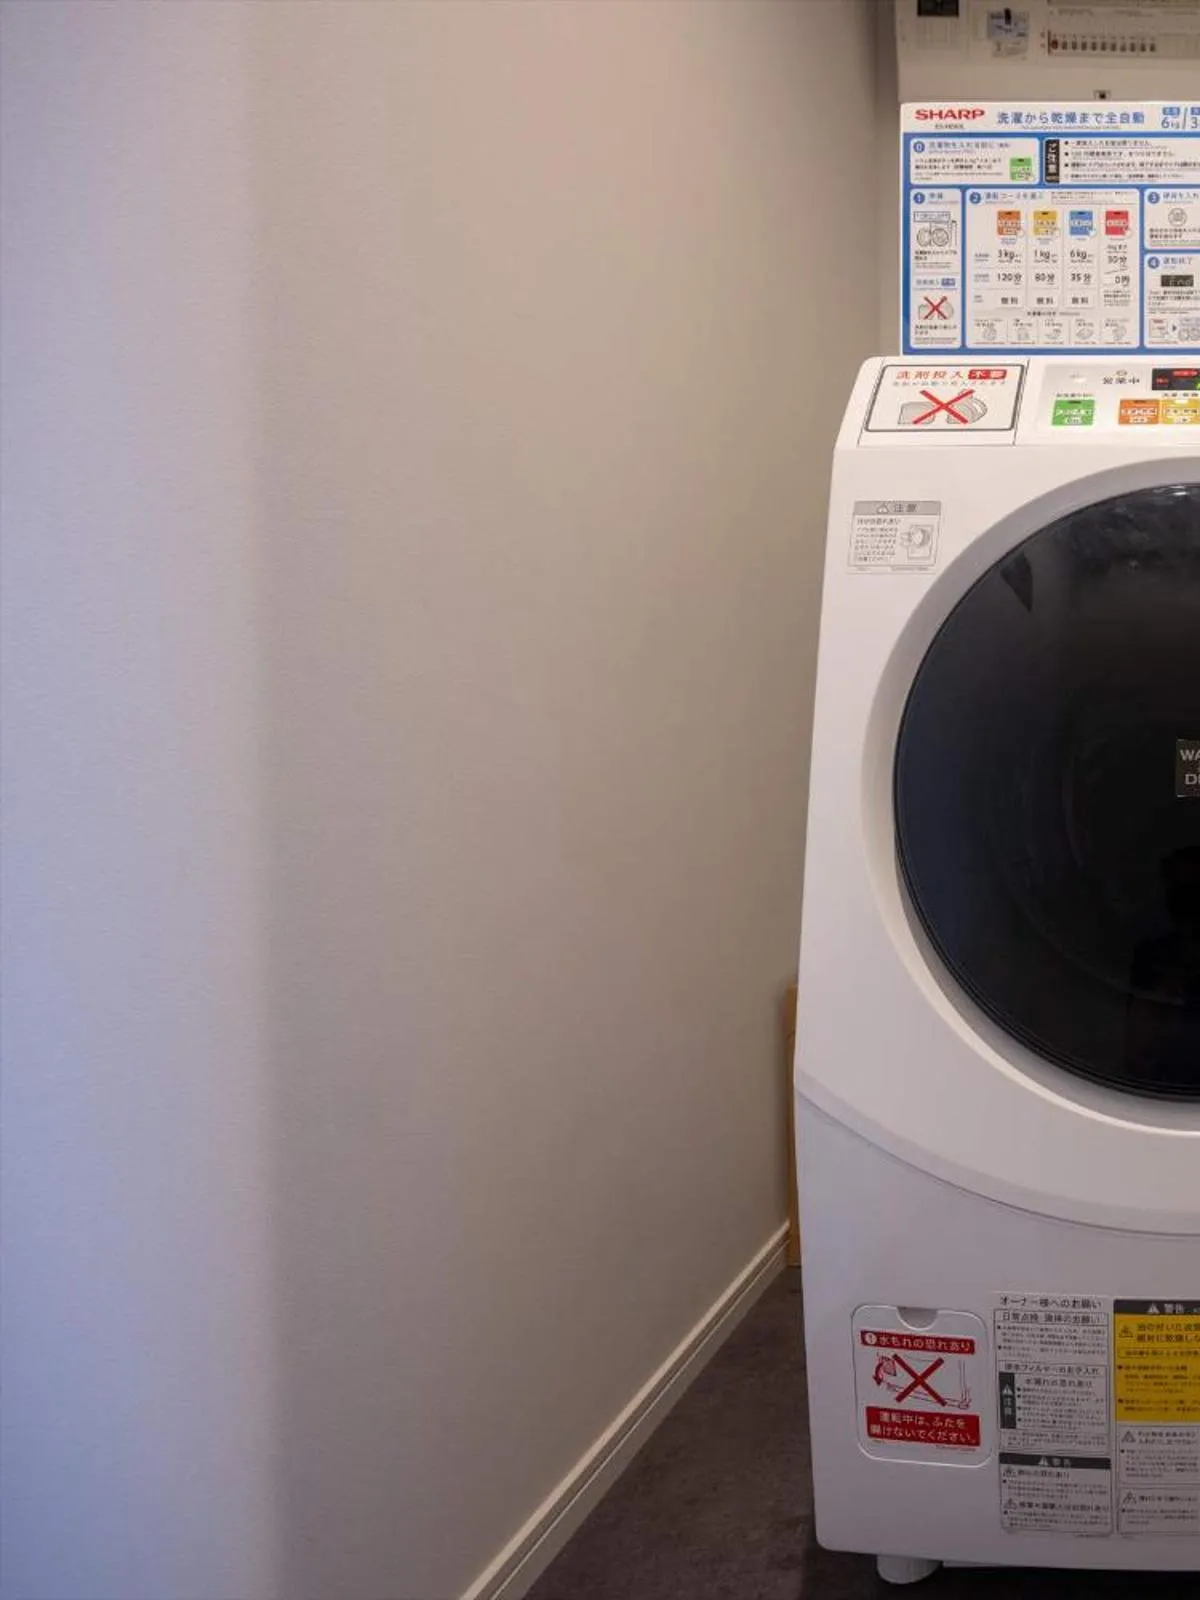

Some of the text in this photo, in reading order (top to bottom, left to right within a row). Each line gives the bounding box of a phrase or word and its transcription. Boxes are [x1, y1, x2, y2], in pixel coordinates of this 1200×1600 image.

[915, 108, 985, 120] SHARP
[997, 111, 1145, 125] 洗濯から乾燥まで全自動
[879, 1335, 971, 1351] 水もれの恐れあり
[879, 1411, 965, 1428] 運転中は、ふたを
